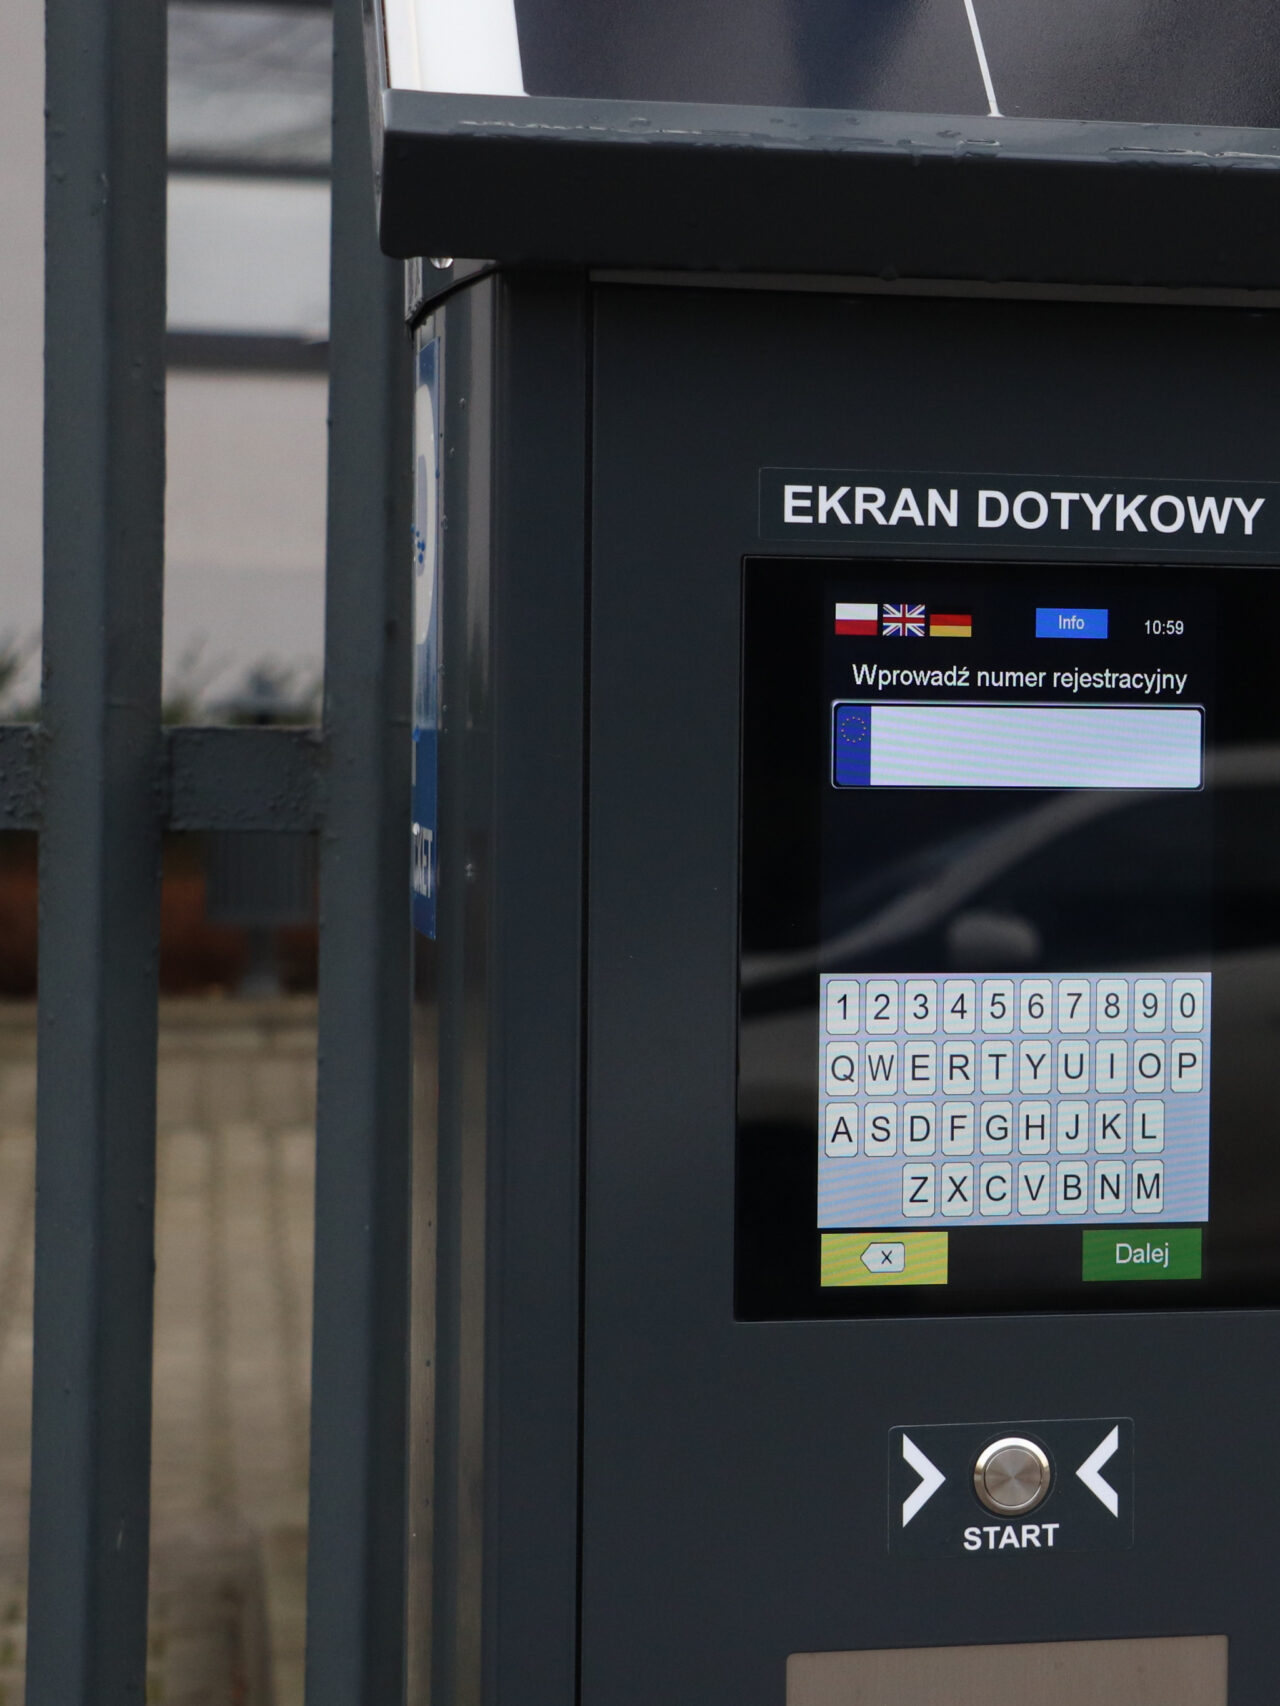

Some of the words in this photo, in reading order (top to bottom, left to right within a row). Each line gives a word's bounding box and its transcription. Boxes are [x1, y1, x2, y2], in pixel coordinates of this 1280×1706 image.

[784, 485, 957, 526] EKRAN
[978, 490, 1265, 534] DOTYKOWY
[1059, 615, 1084, 629] Info
[1145, 620, 1183, 634] 10:59
[853, 664, 969, 690] Wprowadź
[978, 671, 1046, 687] numer
[1054, 667, 1187, 694] rejestracyjny
[838, 994, 847, 1019] 1
[874, 994, 889, 1019] 2
[913, 994, 928, 1019] 3
[951, 993, 967, 1019] 4
[991, 993, 1006, 1019] 5
[1028, 993, 1044, 1019] 6
[1067, 993, 1082, 1018] 7
[1105, 993, 1120, 1018] 8
[1143, 993, 1158, 1018] 9
[1180, 993, 1195, 1018] 0
[831, 1055, 854, 1082] Q
[868, 1055, 894, 1081] W
[912, 1055, 929, 1080] E
[950, 1054, 969, 1080] R
[988, 1054, 1007, 1080] T
[1026, 1054, 1046, 1079] Y
[1065, 1054, 1083, 1079] U
[1110, 1053, 1114, 1079] I
[1139, 1053, 1161, 1078] O
[1179, 1053, 1196, 1078] P
[831, 1117, 852, 1143] A
[872, 1116, 890, 1142] S
[910, 1116, 930, 1142] D
[951, 1115, 967, 1141] F
[986, 1115, 1008, 1140] G
[1026, 1115, 1044, 1140] H
[1066, 1114, 1079, 1139] J
[1103, 1114, 1121, 1139] K
[1142, 1113, 1156, 1139] L
[909, 1177, 928, 1202] Z
[948, 1176, 968, 1202] X
[986, 1176, 1006, 1201] C
[1024, 1175, 1045, 1200] V
[1064, 1175, 1081, 1200] B
[1101, 1174, 1119, 1199] N
[1137, 1173, 1159, 1199] M
[1116, 1243, 1168, 1267] Dalej
[964, 1524, 1059, 1550] START
